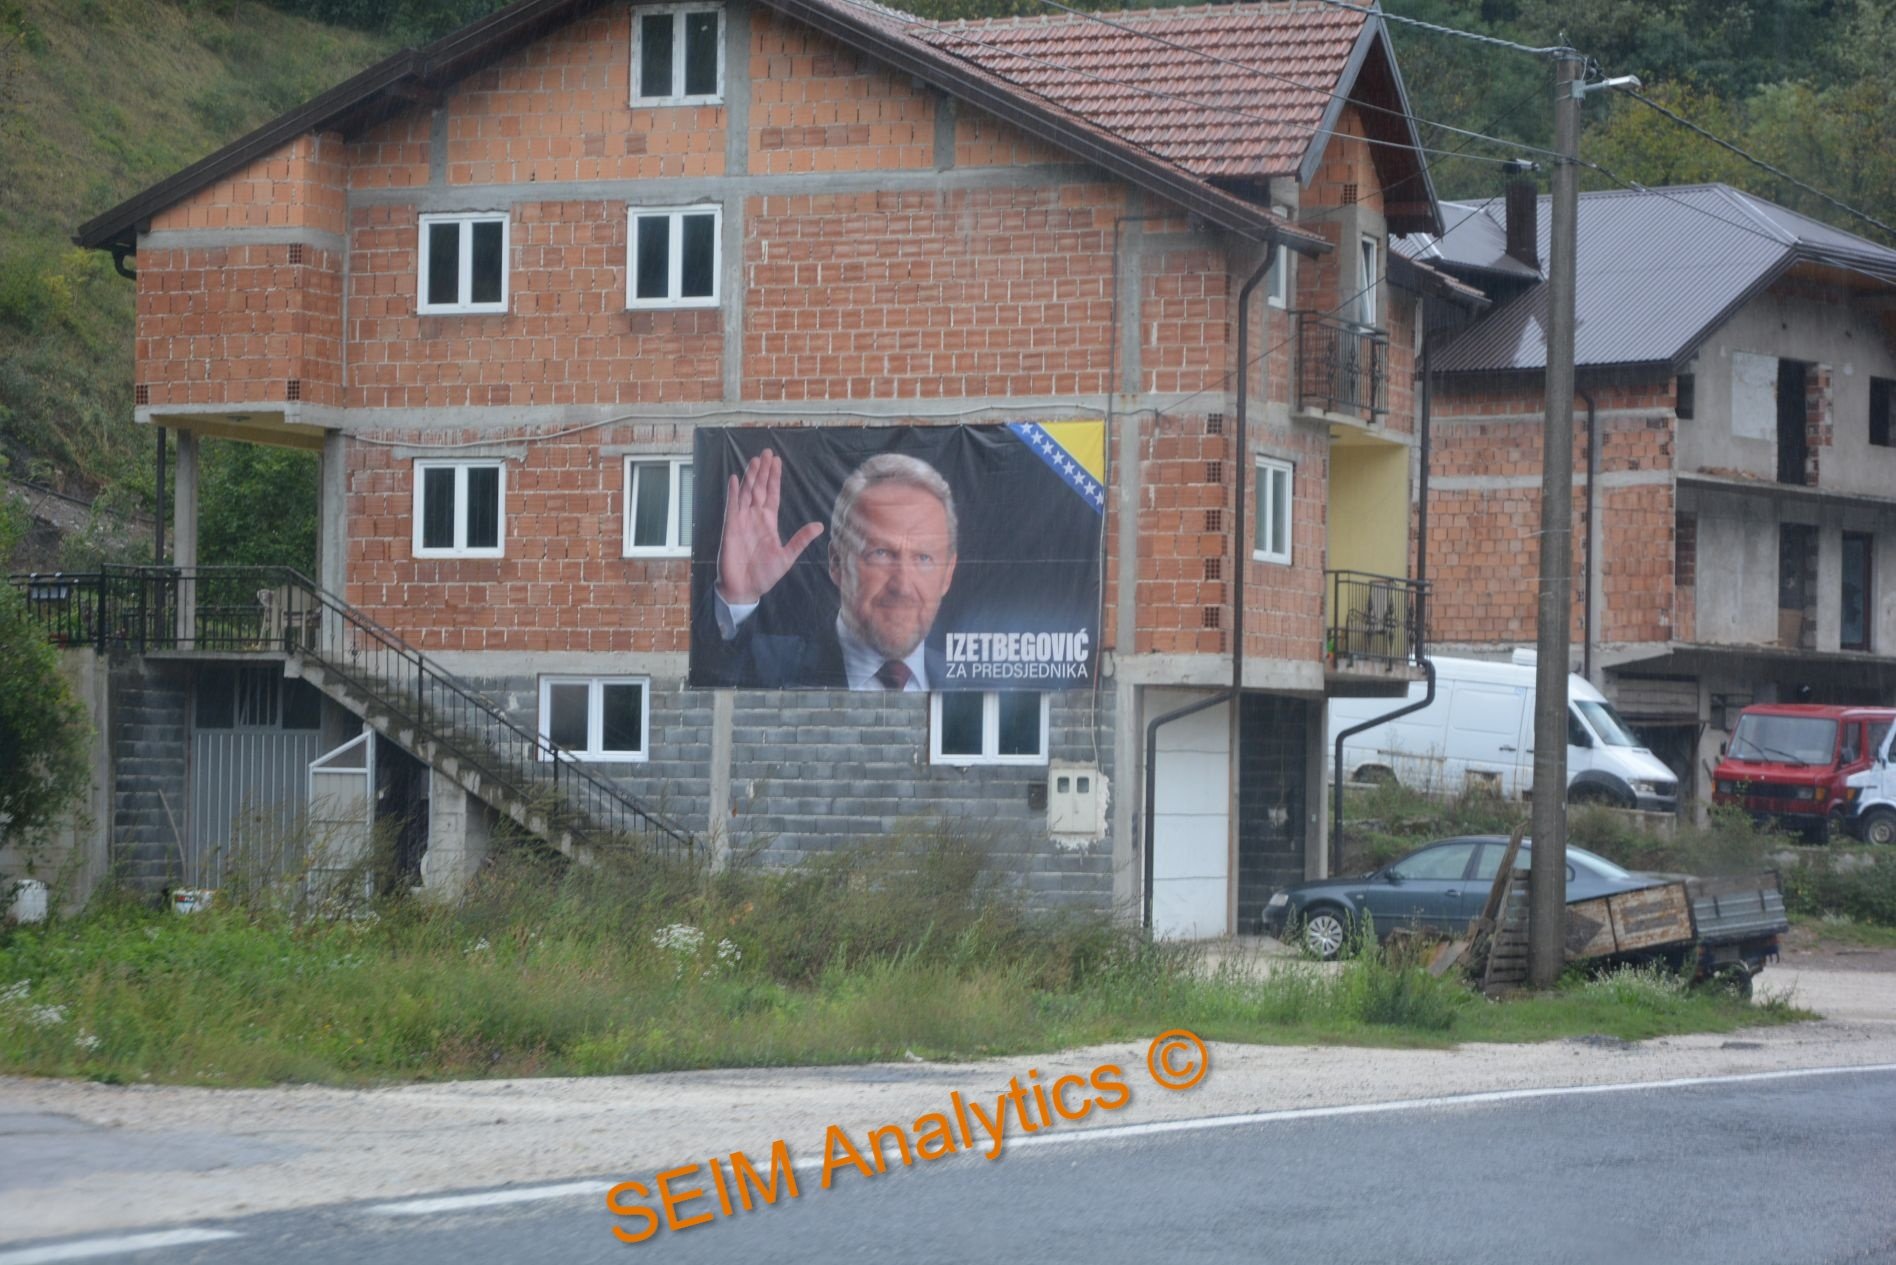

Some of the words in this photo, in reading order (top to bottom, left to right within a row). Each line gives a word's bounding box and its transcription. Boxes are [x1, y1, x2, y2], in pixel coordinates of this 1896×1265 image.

[946, 628, 1089, 662] IZETBEGOVIĆ
[946, 663, 967, 678] ZA
[972, 663, 1088, 678] PREDSJEDNIKA
